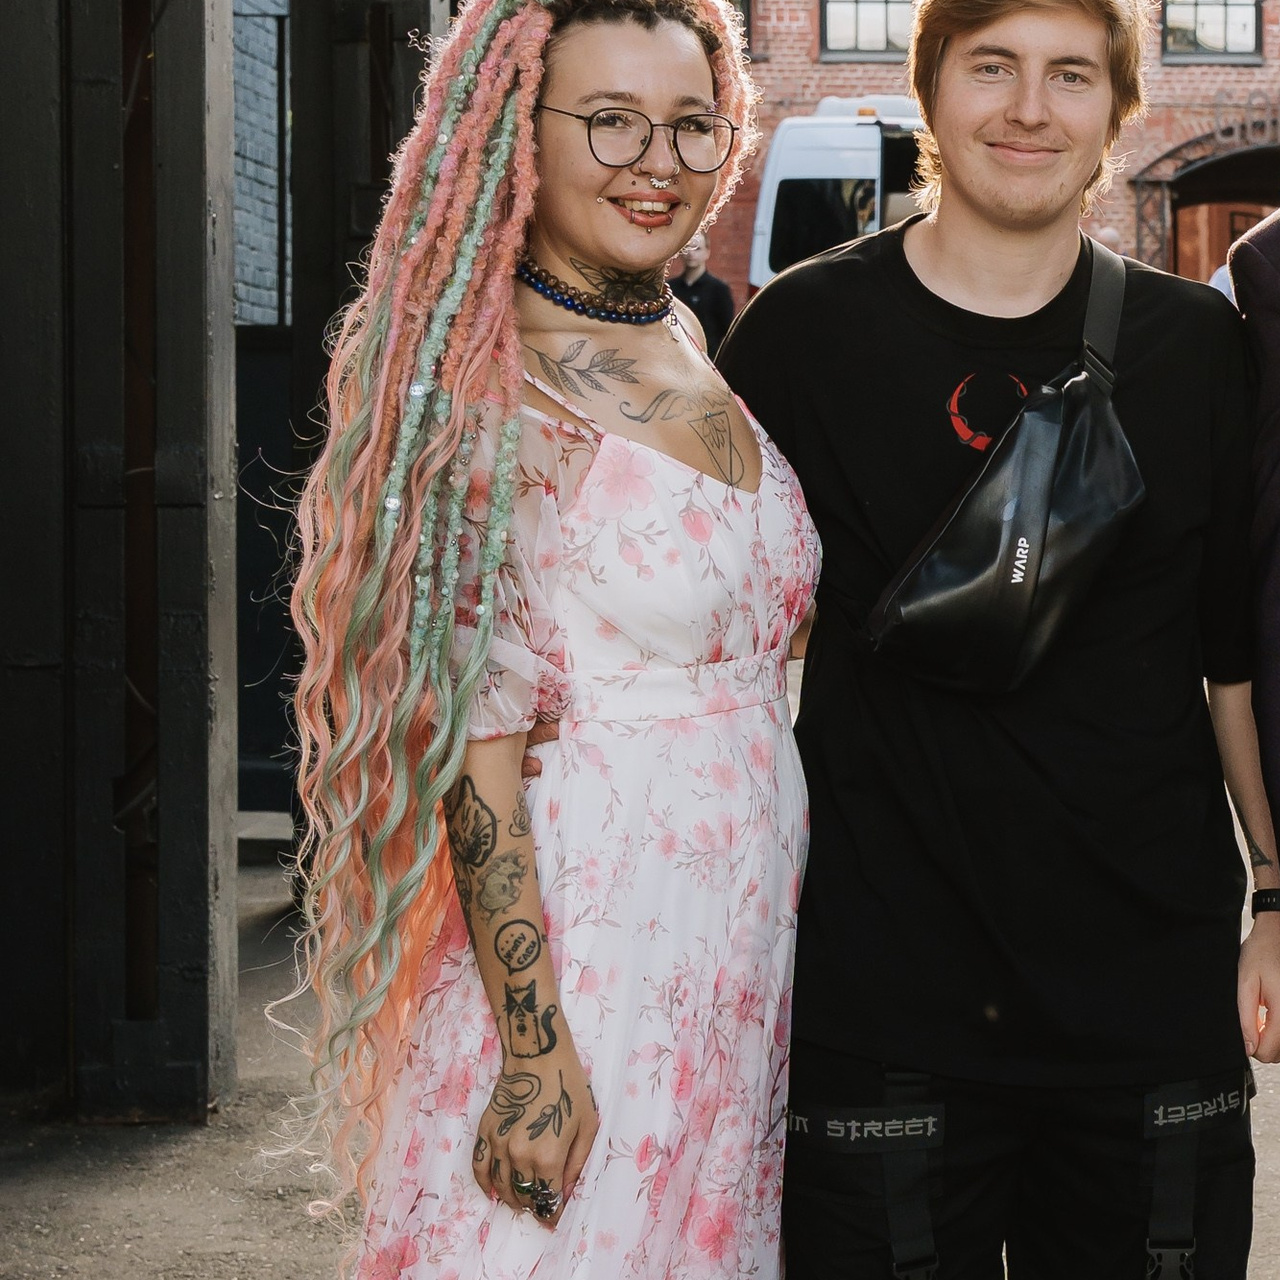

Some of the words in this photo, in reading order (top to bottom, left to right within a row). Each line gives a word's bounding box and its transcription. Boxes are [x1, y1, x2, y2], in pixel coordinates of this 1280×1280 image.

[1010, 536, 1030, 583] WARP
[1154, 1090, 1240, 1126] STREET
[826, 1115, 938, 1142] STREET
